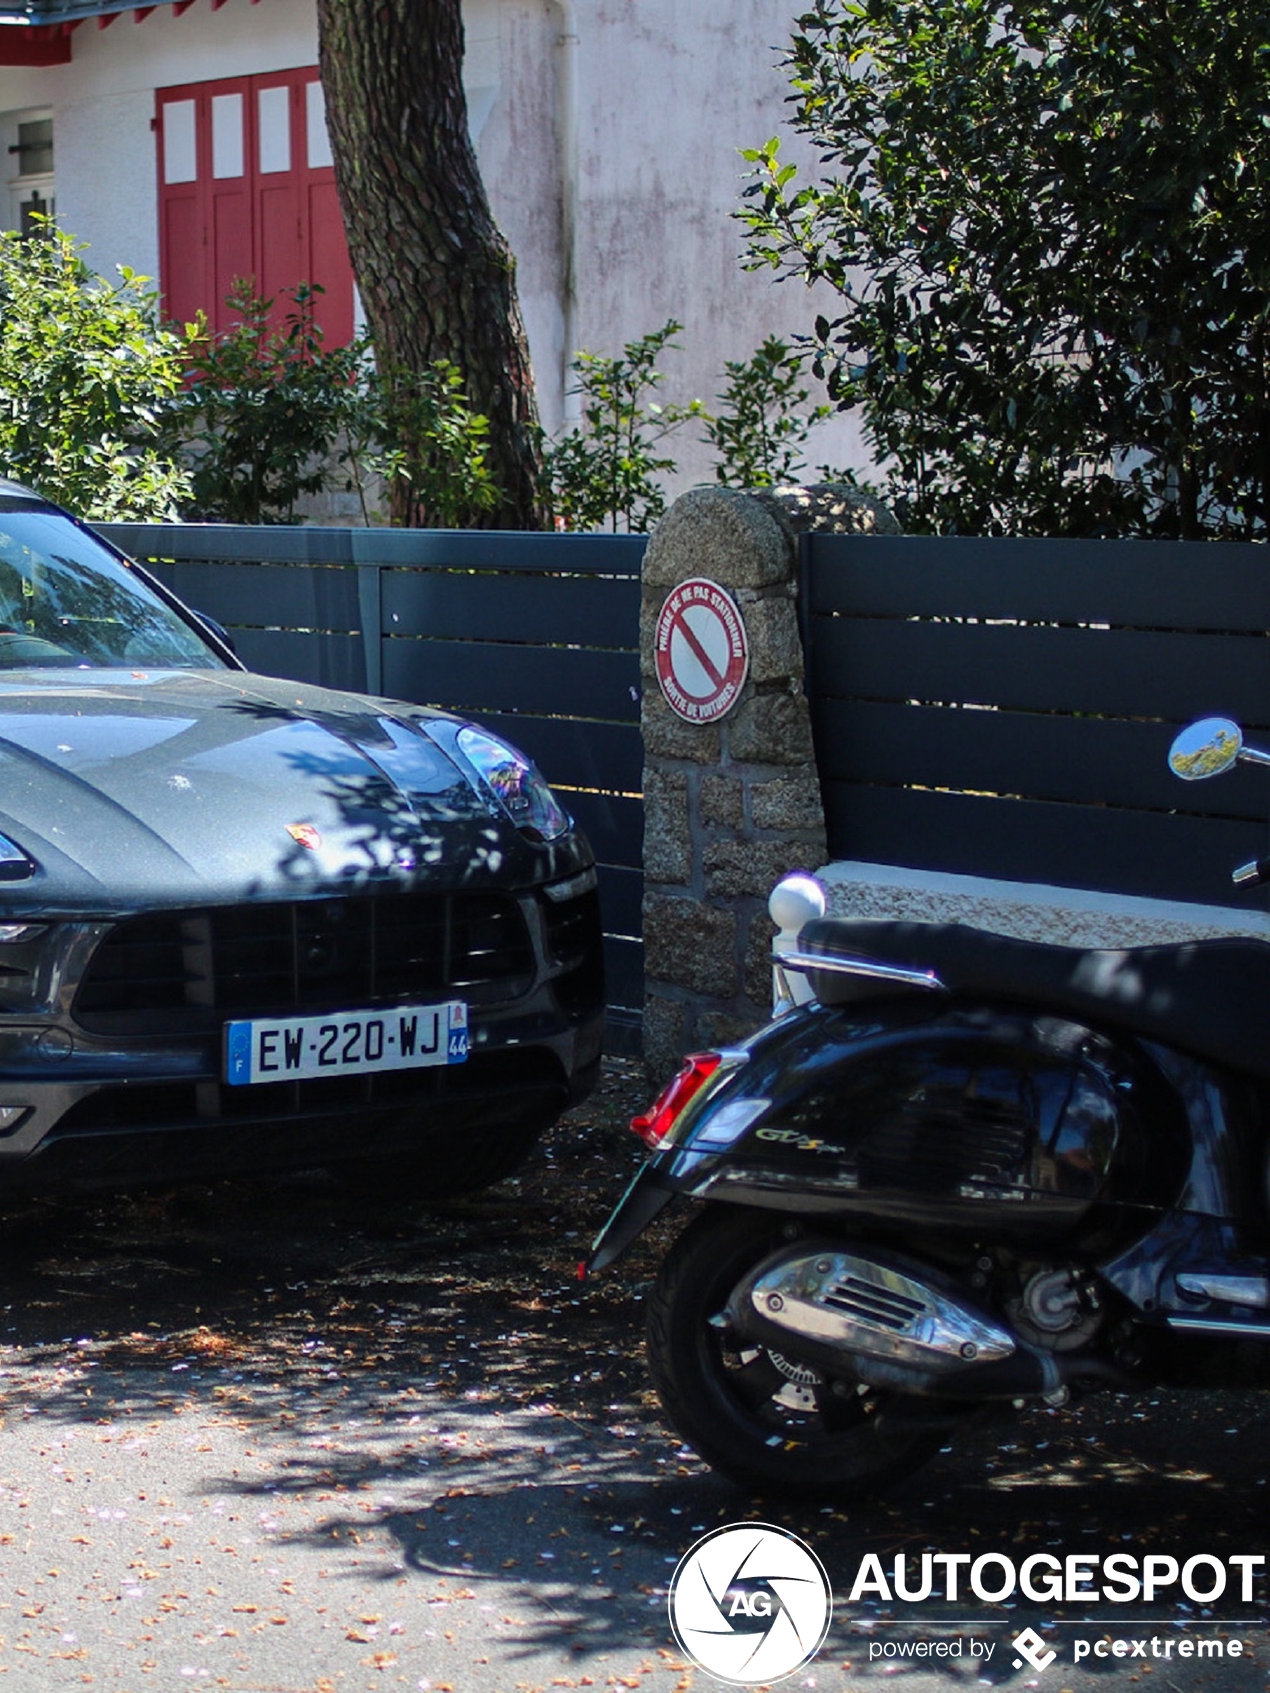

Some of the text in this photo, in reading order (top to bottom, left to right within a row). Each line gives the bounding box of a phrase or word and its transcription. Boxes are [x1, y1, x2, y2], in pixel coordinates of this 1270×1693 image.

[670, 596, 682, 612] DE
[681, 587, 693, 602] NE
[694, 586, 709, 601] PAS
[663, 676, 736, 718] SORTIE DE VOITURES
[259, 1013, 439, 1072] EW-220-WJ
[449, 1035, 466, 1056] 44
[235, 1060, 243, 1072] F
